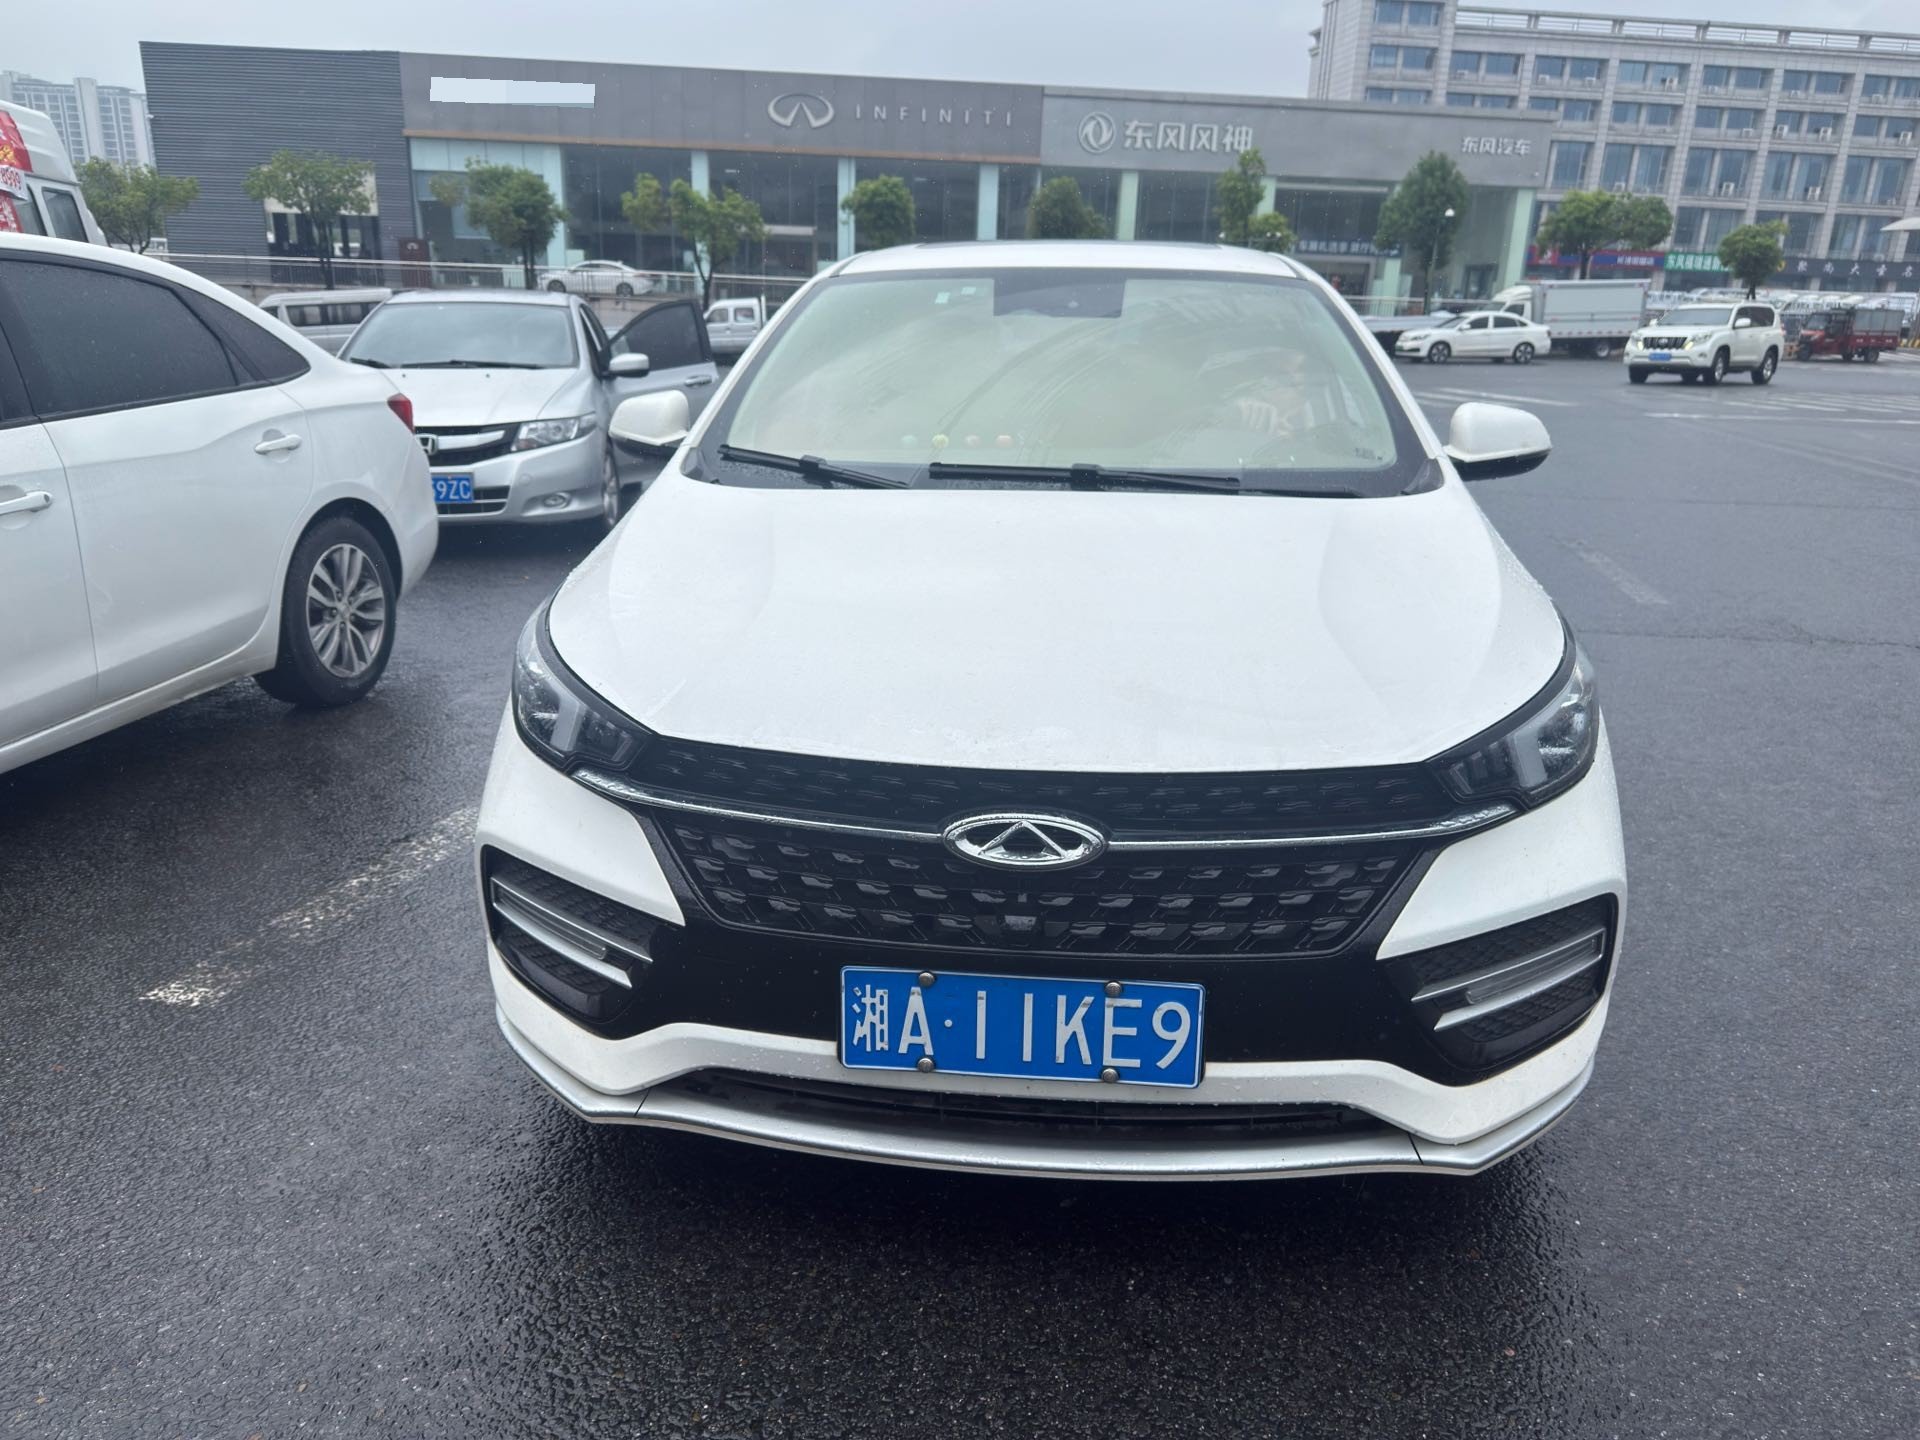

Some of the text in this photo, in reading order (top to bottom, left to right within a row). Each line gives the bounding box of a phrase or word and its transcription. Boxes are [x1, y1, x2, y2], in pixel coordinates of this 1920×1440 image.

[854, 103, 1012, 127] INFINITI
[1123, 120, 1253, 153] 东风风神
[1461, 136, 1532, 155] 东风汽车
[432, 479, 471, 500] 9ZC
